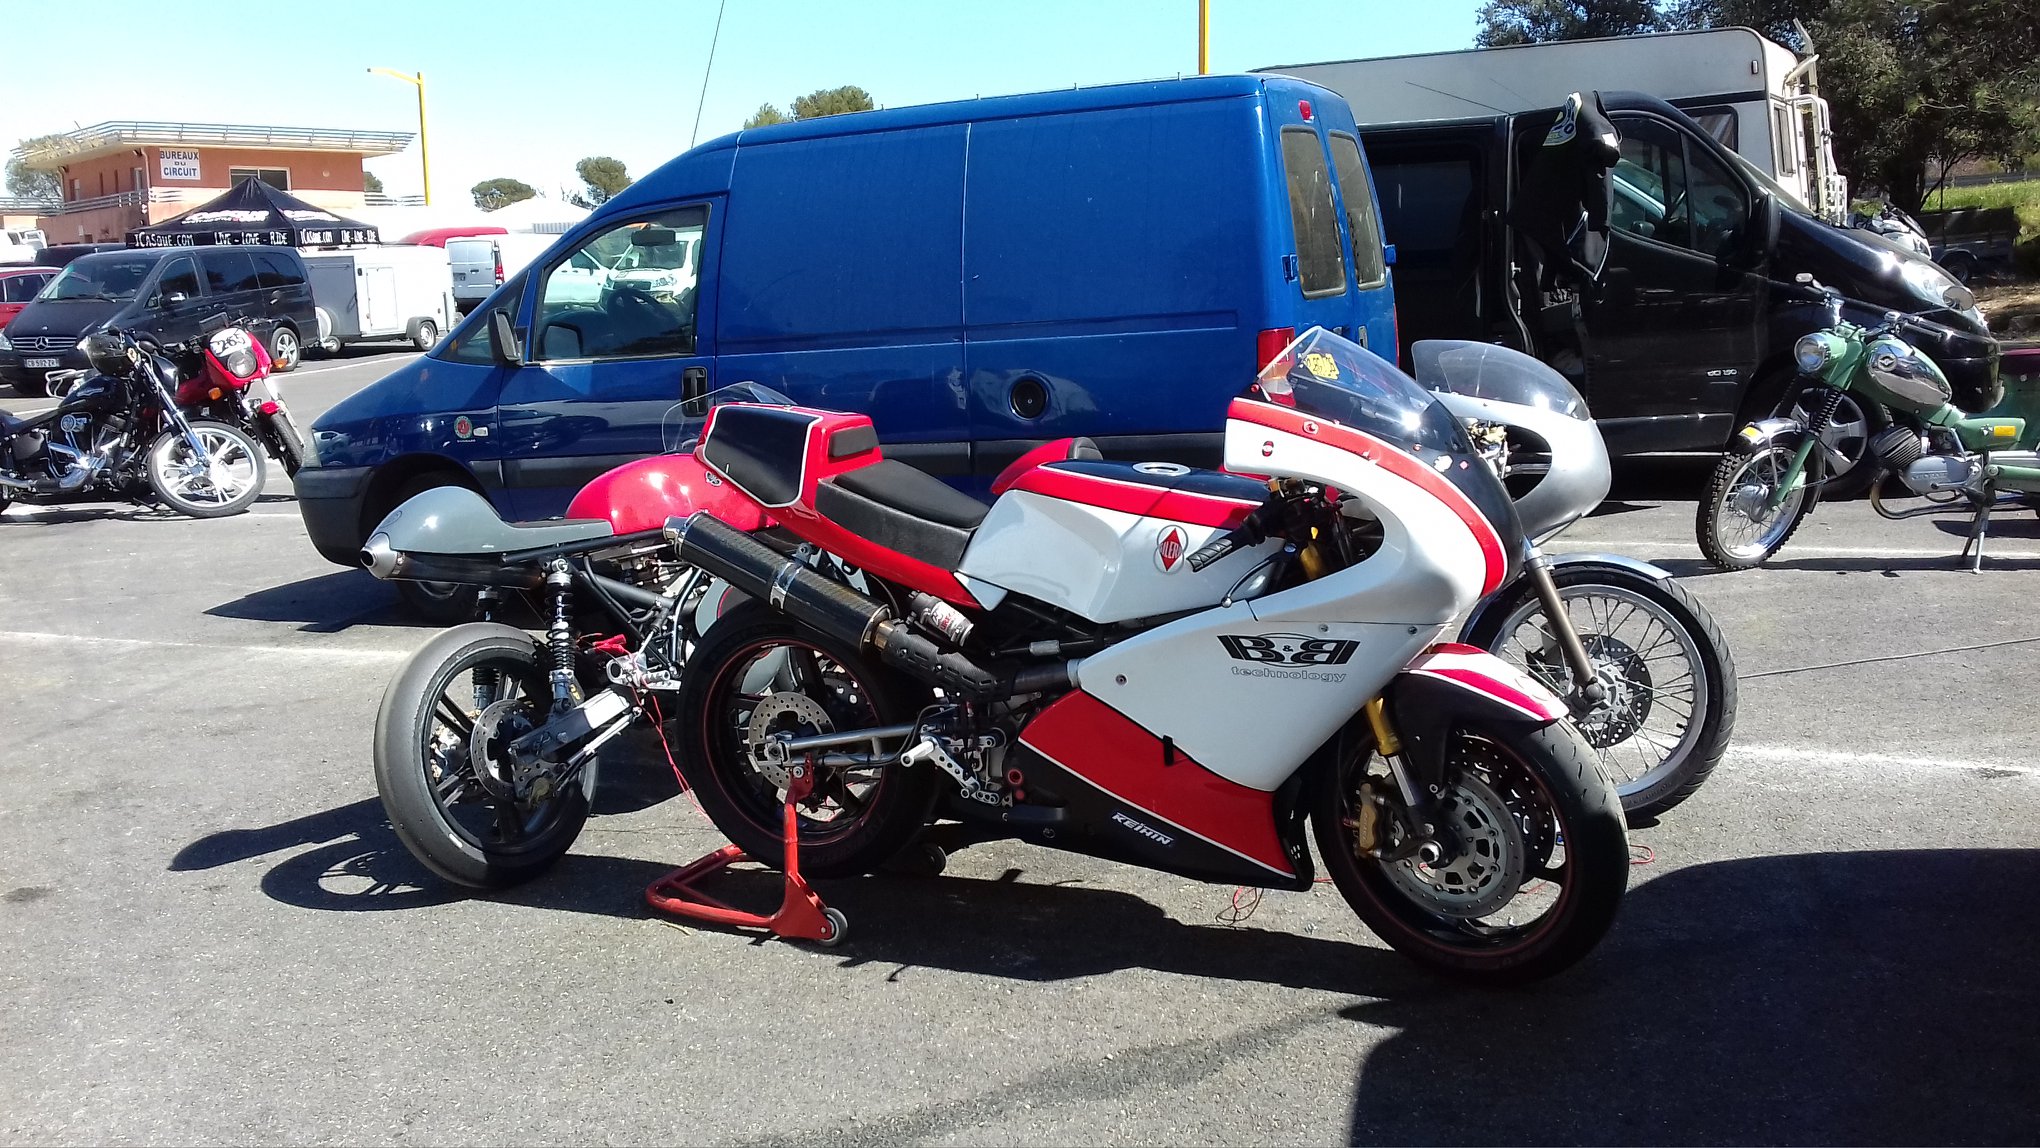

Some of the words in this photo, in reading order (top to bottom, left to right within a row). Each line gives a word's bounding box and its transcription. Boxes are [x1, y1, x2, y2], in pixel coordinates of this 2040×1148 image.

[160, 151, 199, 160] BUREAUX
[163, 167, 197, 177] CIRCUIT
[214, 231, 231, 245] LIVE
[241, 231, 260, 245] LOVE
[269, 231, 288, 245] RIDE
[1231, 666, 1346, 683] technology
[1112, 812, 1174, 845] KEIHIN
